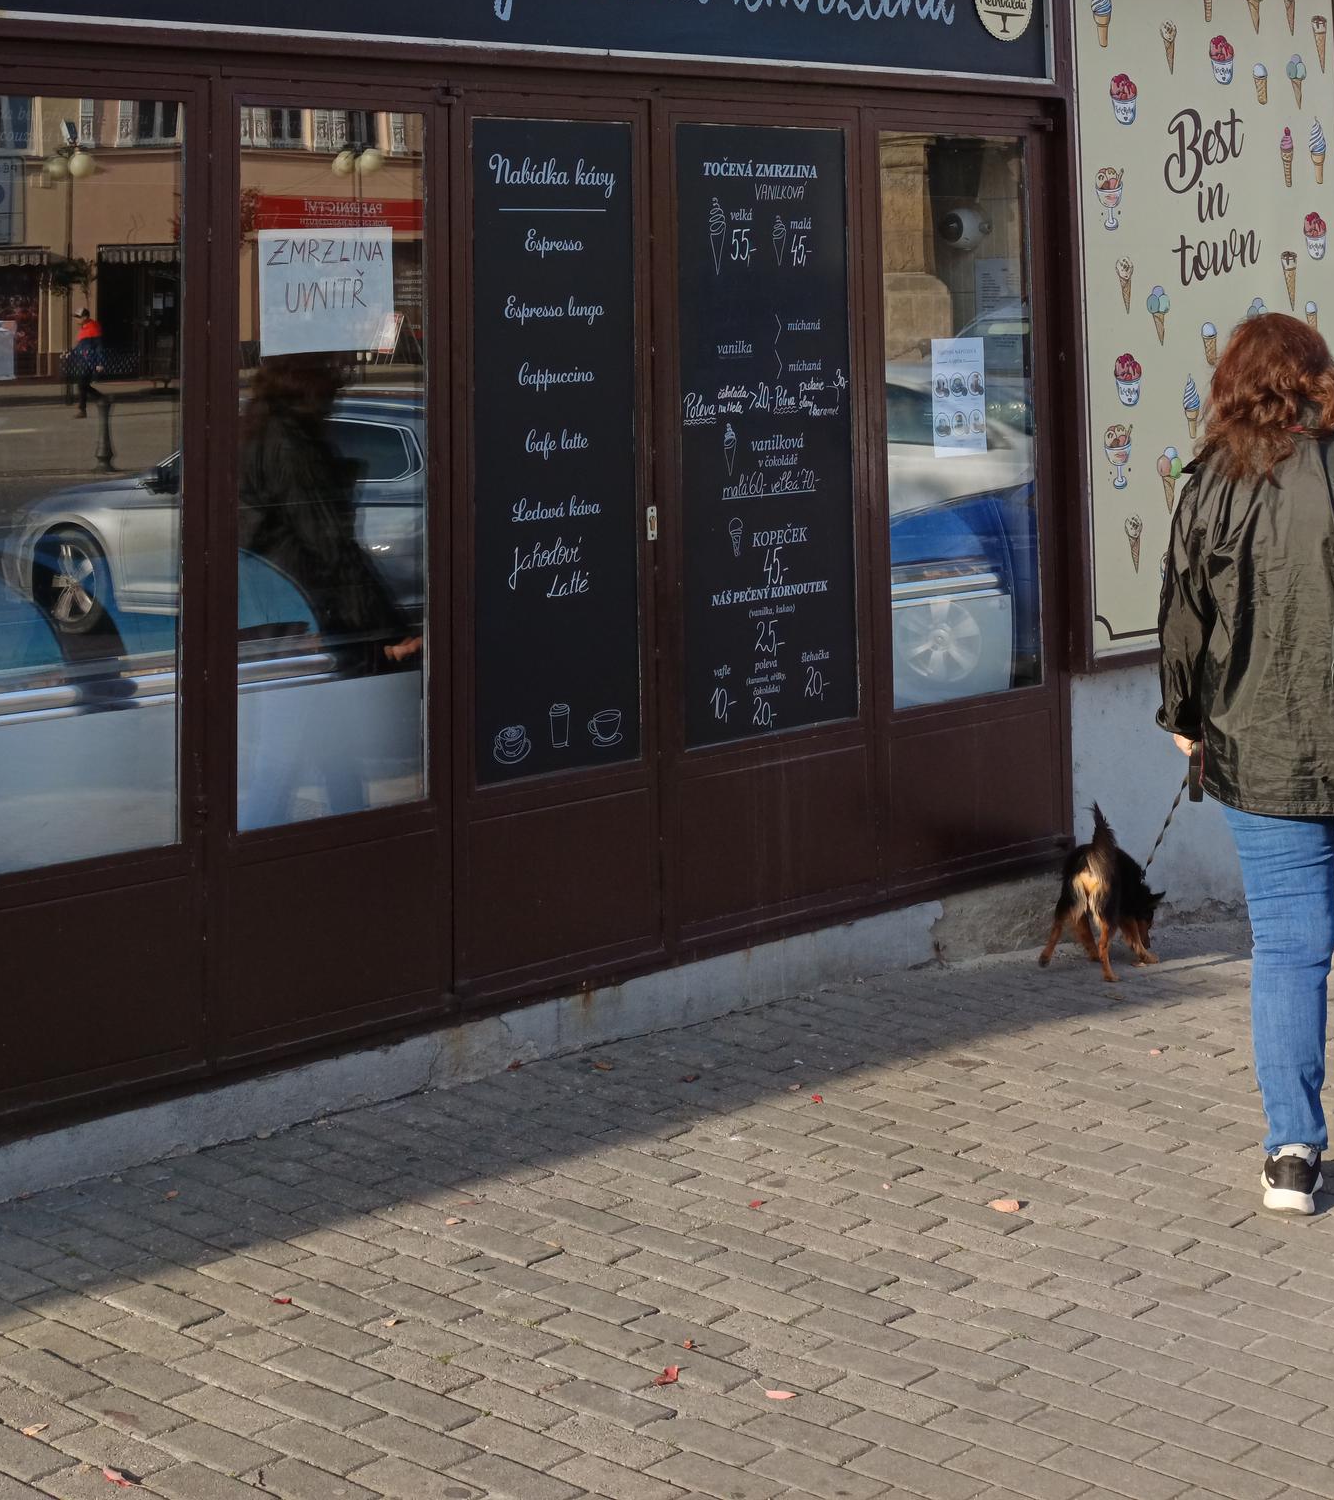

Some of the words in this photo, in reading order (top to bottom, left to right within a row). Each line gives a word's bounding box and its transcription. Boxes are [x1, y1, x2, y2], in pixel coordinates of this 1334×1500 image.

[1164, 108, 1245, 194] Best
[489, 153, 570, 185] Nabídka
[575, 158, 616, 199] kávy
[703, 156, 754, 177] TOČENÁ
[755, 163, 818, 179] ZMRZLINA
[754, 180, 808, 201] VANILKOVÁ
[1197, 180, 1229, 224] in
[730, 207, 753, 221] velká
[790, 217, 812, 230] malá
[266, 238, 385, 266] ZMRZLINA
[524, 228, 584, 259] Espresso
[730, 228, 757, 268] 55,-
[790, 234, 812, 267] 45,-
[1172, 228, 1261, 287] town
[285, 269, 368, 314] UVNITŘ
[504, 295, 565, 326] Espresso
[568, 296, 605, 326] lungo
[787, 319, 821, 331] míchaná
[717, 340, 753, 355] vanilka
[518, 361, 595, 392] Cappuccino
[788, 359, 822, 372] míchaná
[684, 392, 716, 419] Poleva
[774, 385, 796, 411] Poleva
[525, 429, 557, 461] Cafe
[561, 428, 589, 450] latte
[751, 432, 804, 452] vanilková
[758, 459, 764, 468] v
[765, 454, 798, 468] čokoládě
[512, 497, 566, 523] Ledová
[569, 494, 602, 517] káva
[752, 523, 808, 548] KOPEČEK
[712, 590, 732, 606] NÁŠ
[733, 585, 769, 603] PEČENÝ
[771, 580, 828, 599] KORNOUTEK
[754, 659, 778, 673] poleva
[801, 649, 830, 663] šlehačka
[713, 665, 732, 679] vafle
